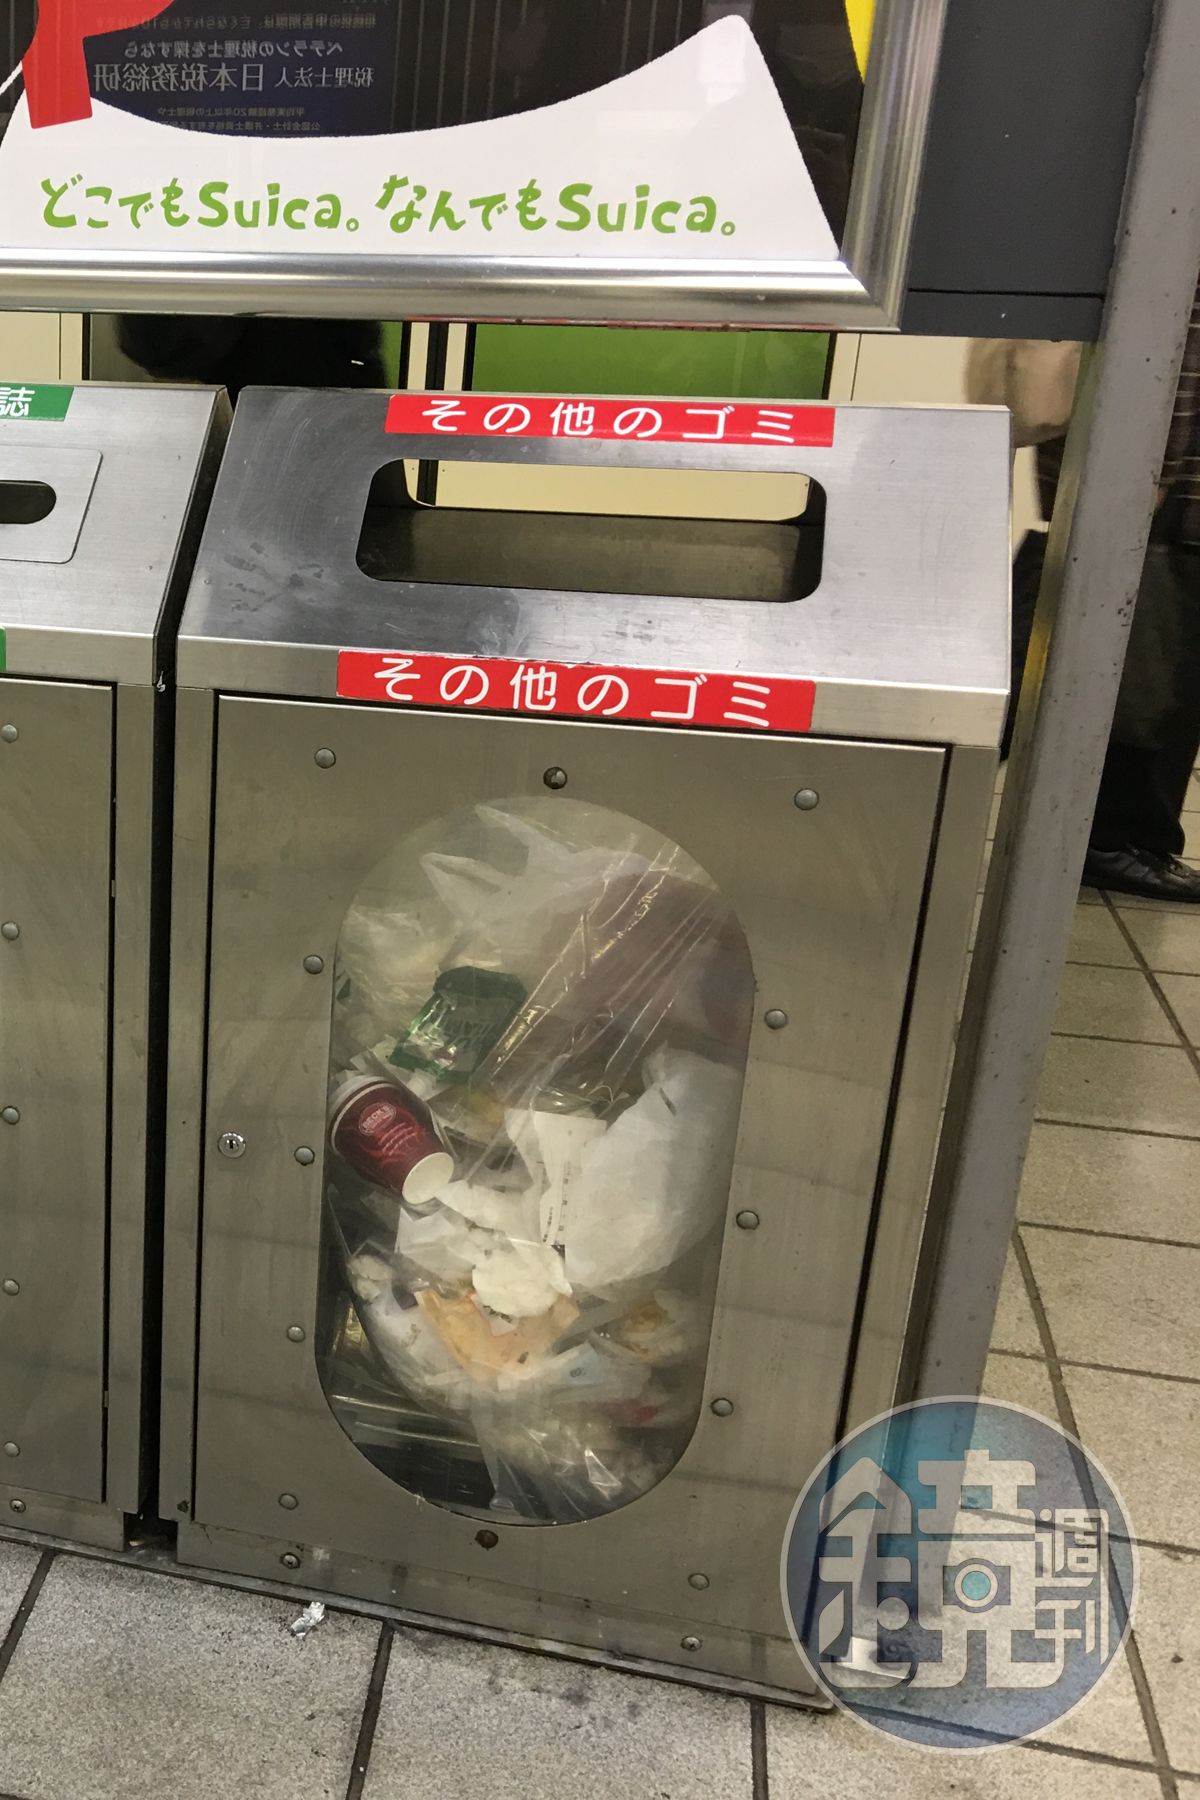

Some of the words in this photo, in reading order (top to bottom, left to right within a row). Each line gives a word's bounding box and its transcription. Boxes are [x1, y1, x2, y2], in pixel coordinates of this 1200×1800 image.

[422, 399, 795, 444] その他のゴミ
[374, 657, 770, 727] その他のゴミ
